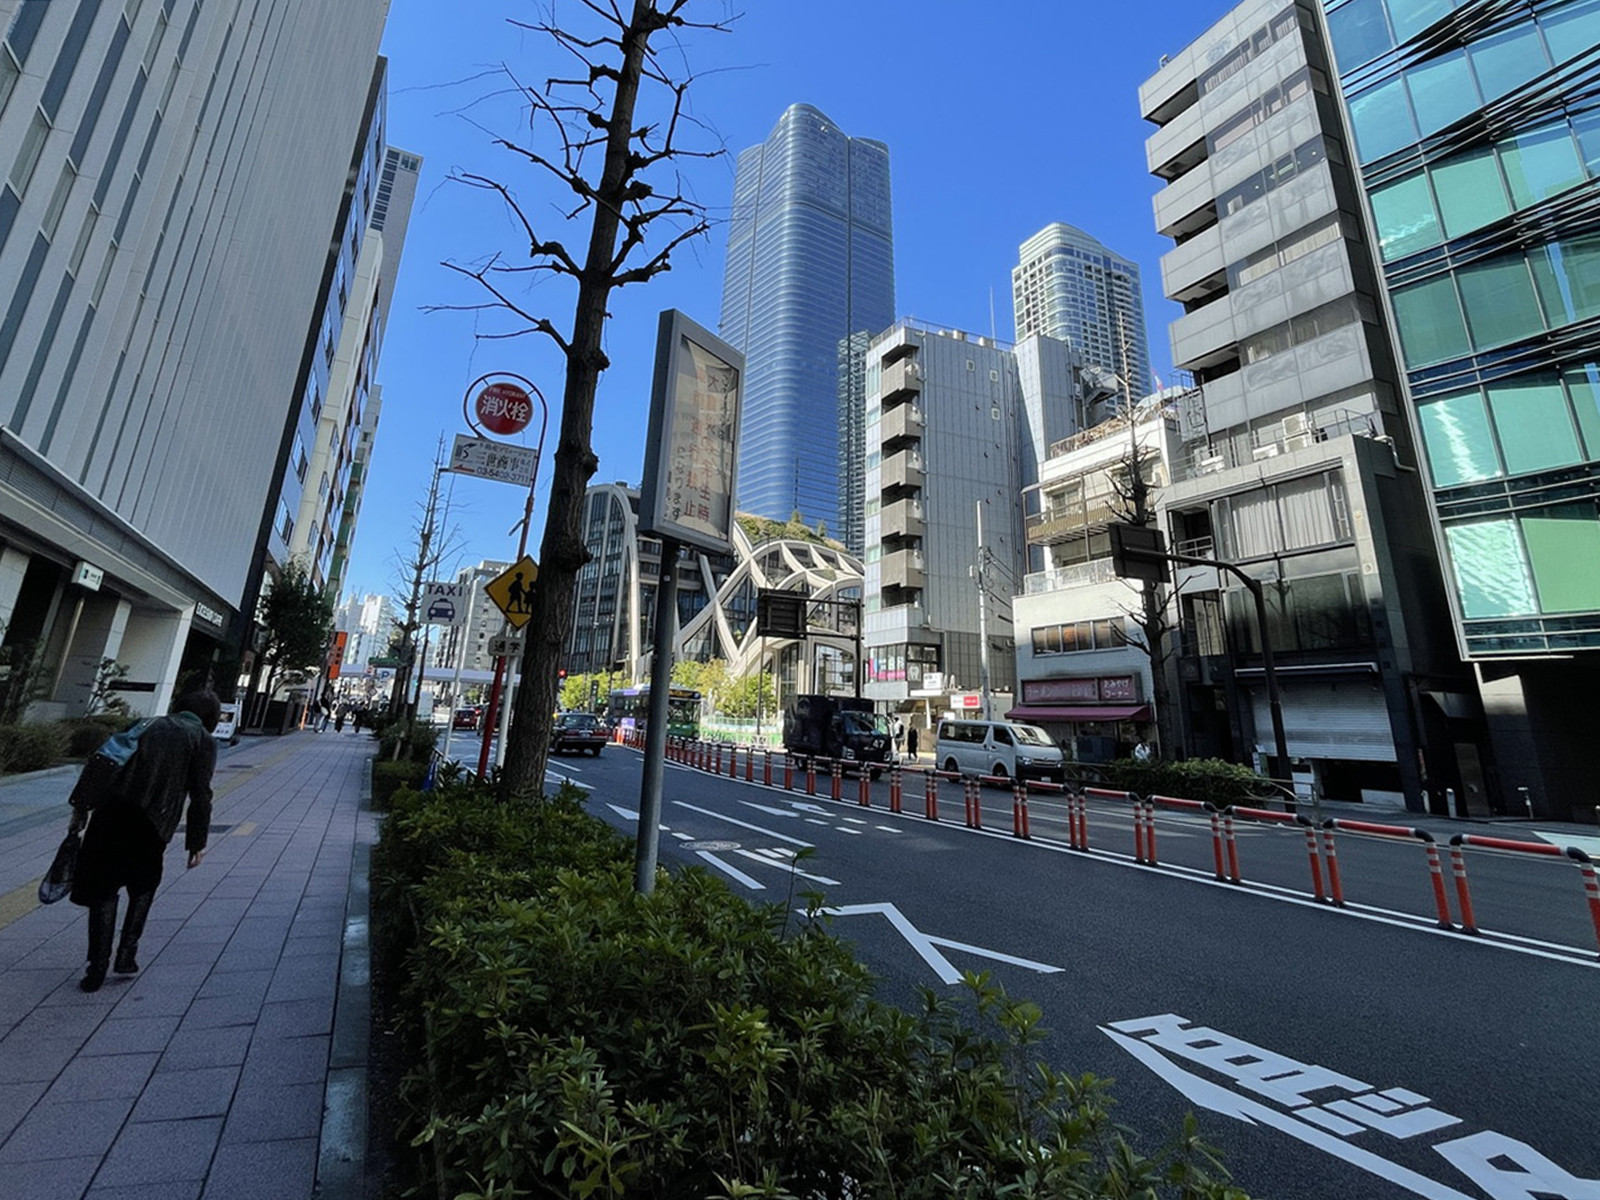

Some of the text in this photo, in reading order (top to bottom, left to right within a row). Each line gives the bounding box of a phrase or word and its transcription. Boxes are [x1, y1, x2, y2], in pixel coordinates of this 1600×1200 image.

[480, 394, 529, 422] 消火栓
[427, 584, 463, 597] TAXI
[873, 740, 885, 749] 47
